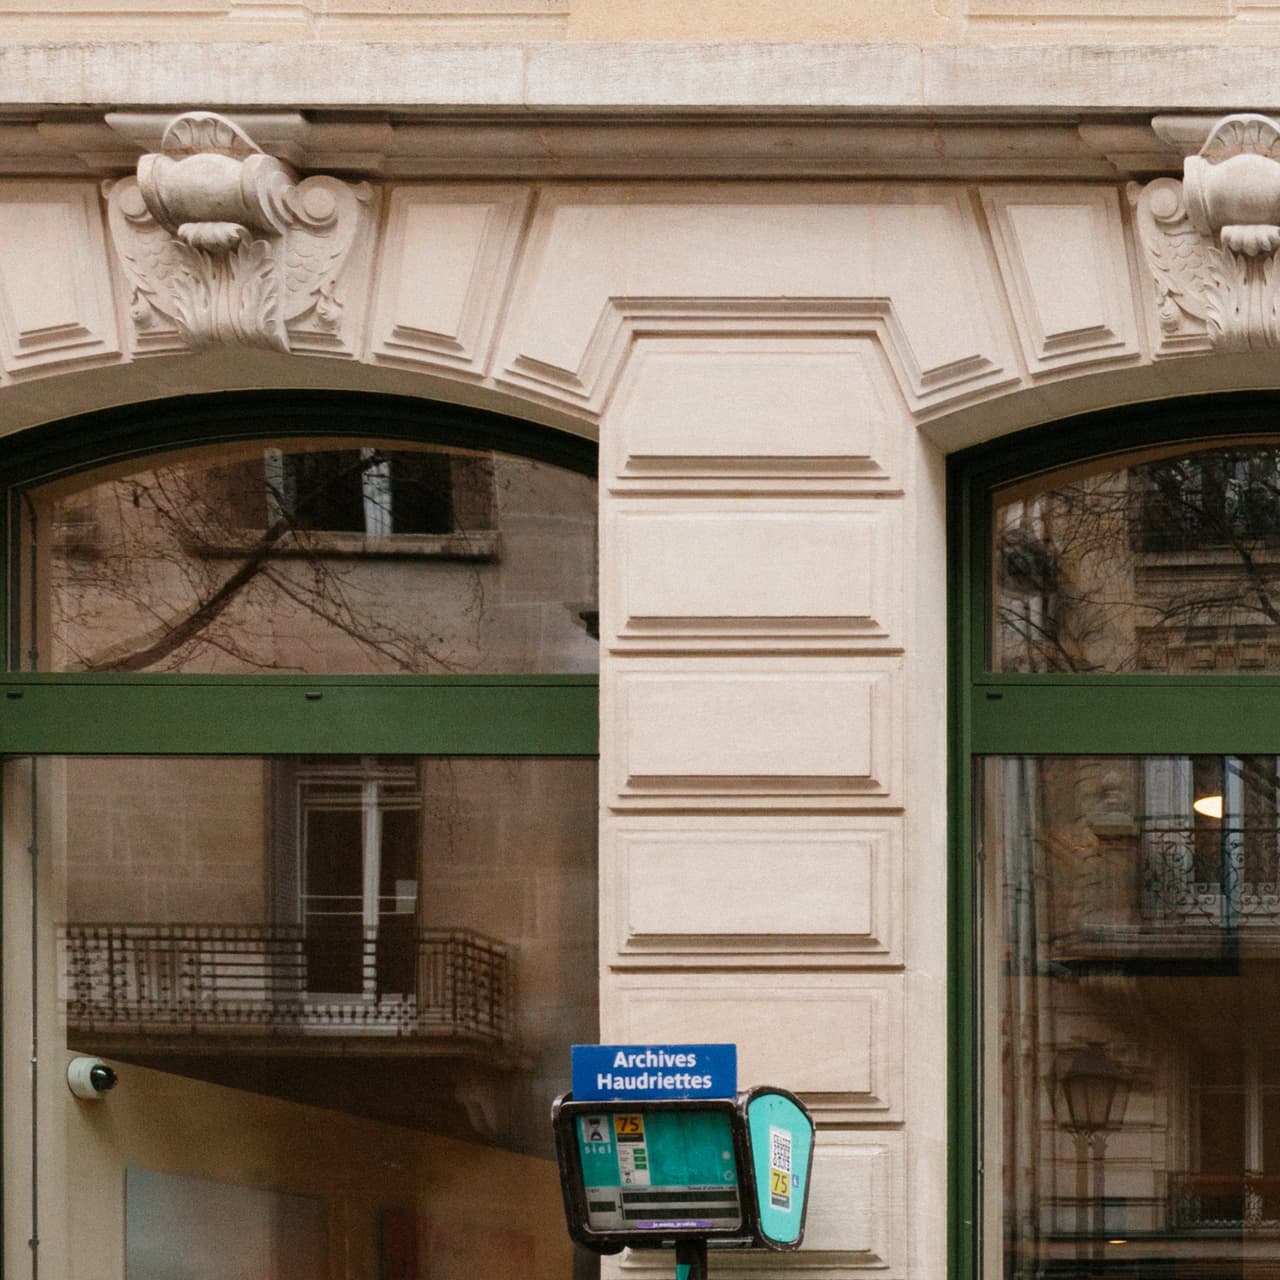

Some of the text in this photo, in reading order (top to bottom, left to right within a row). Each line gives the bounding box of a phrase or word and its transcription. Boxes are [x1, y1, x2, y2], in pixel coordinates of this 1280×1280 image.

[613, 1050, 697, 1068] Archives
[597, 1072, 712, 1090] Haudriettes
[618, 1117, 639, 1132] 75
[773, 1172, 788, 1194] 75
